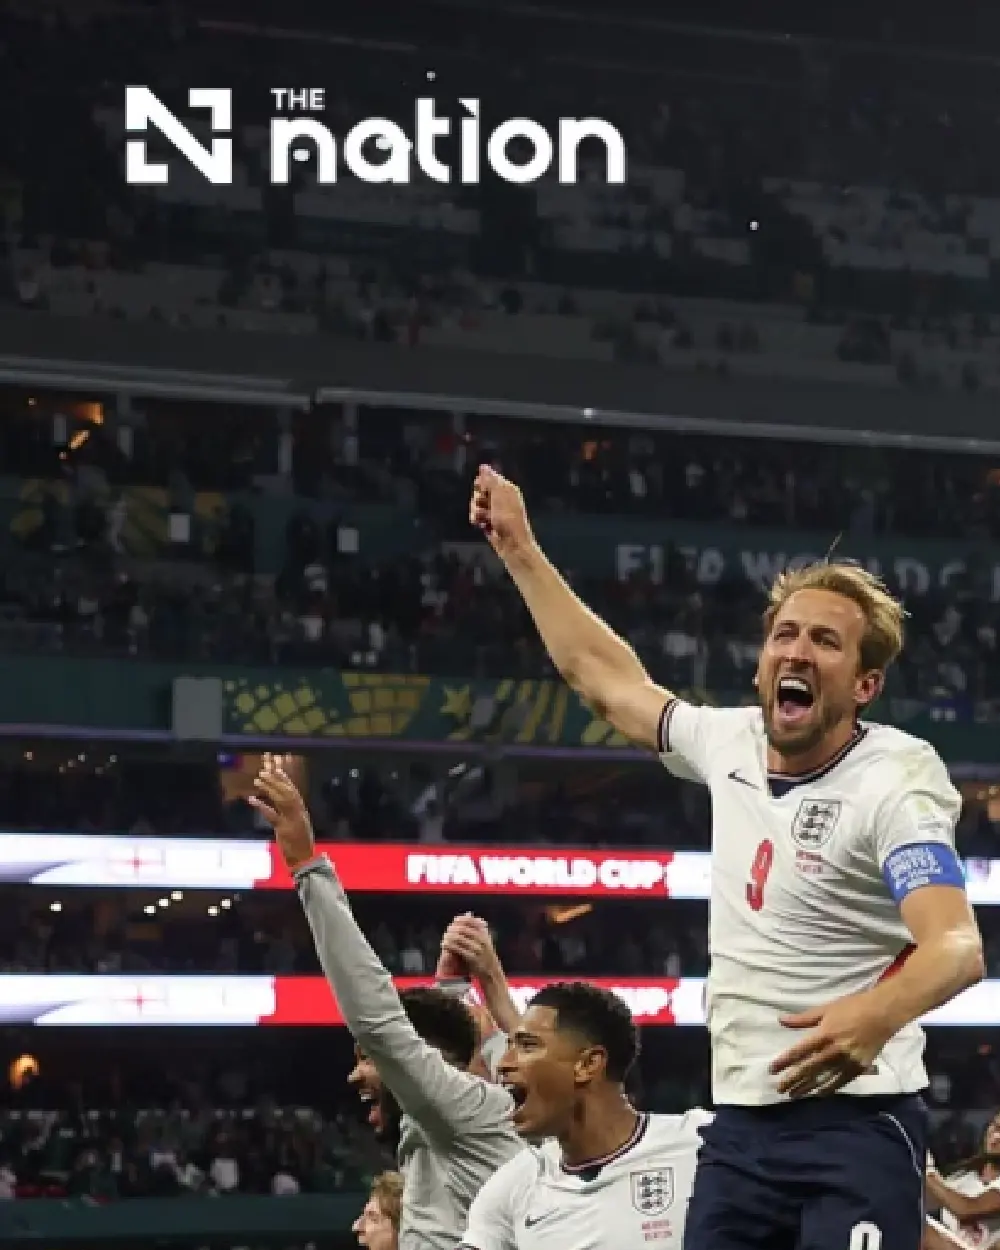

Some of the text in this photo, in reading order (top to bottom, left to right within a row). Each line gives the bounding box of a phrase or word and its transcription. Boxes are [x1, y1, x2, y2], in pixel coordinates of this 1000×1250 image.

[407, 855, 478, 884] FIFA
[480, 856, 597, 887] WORLD
[599, 860, 663, 888] CUP
[745, 838, 774, 911] 9
